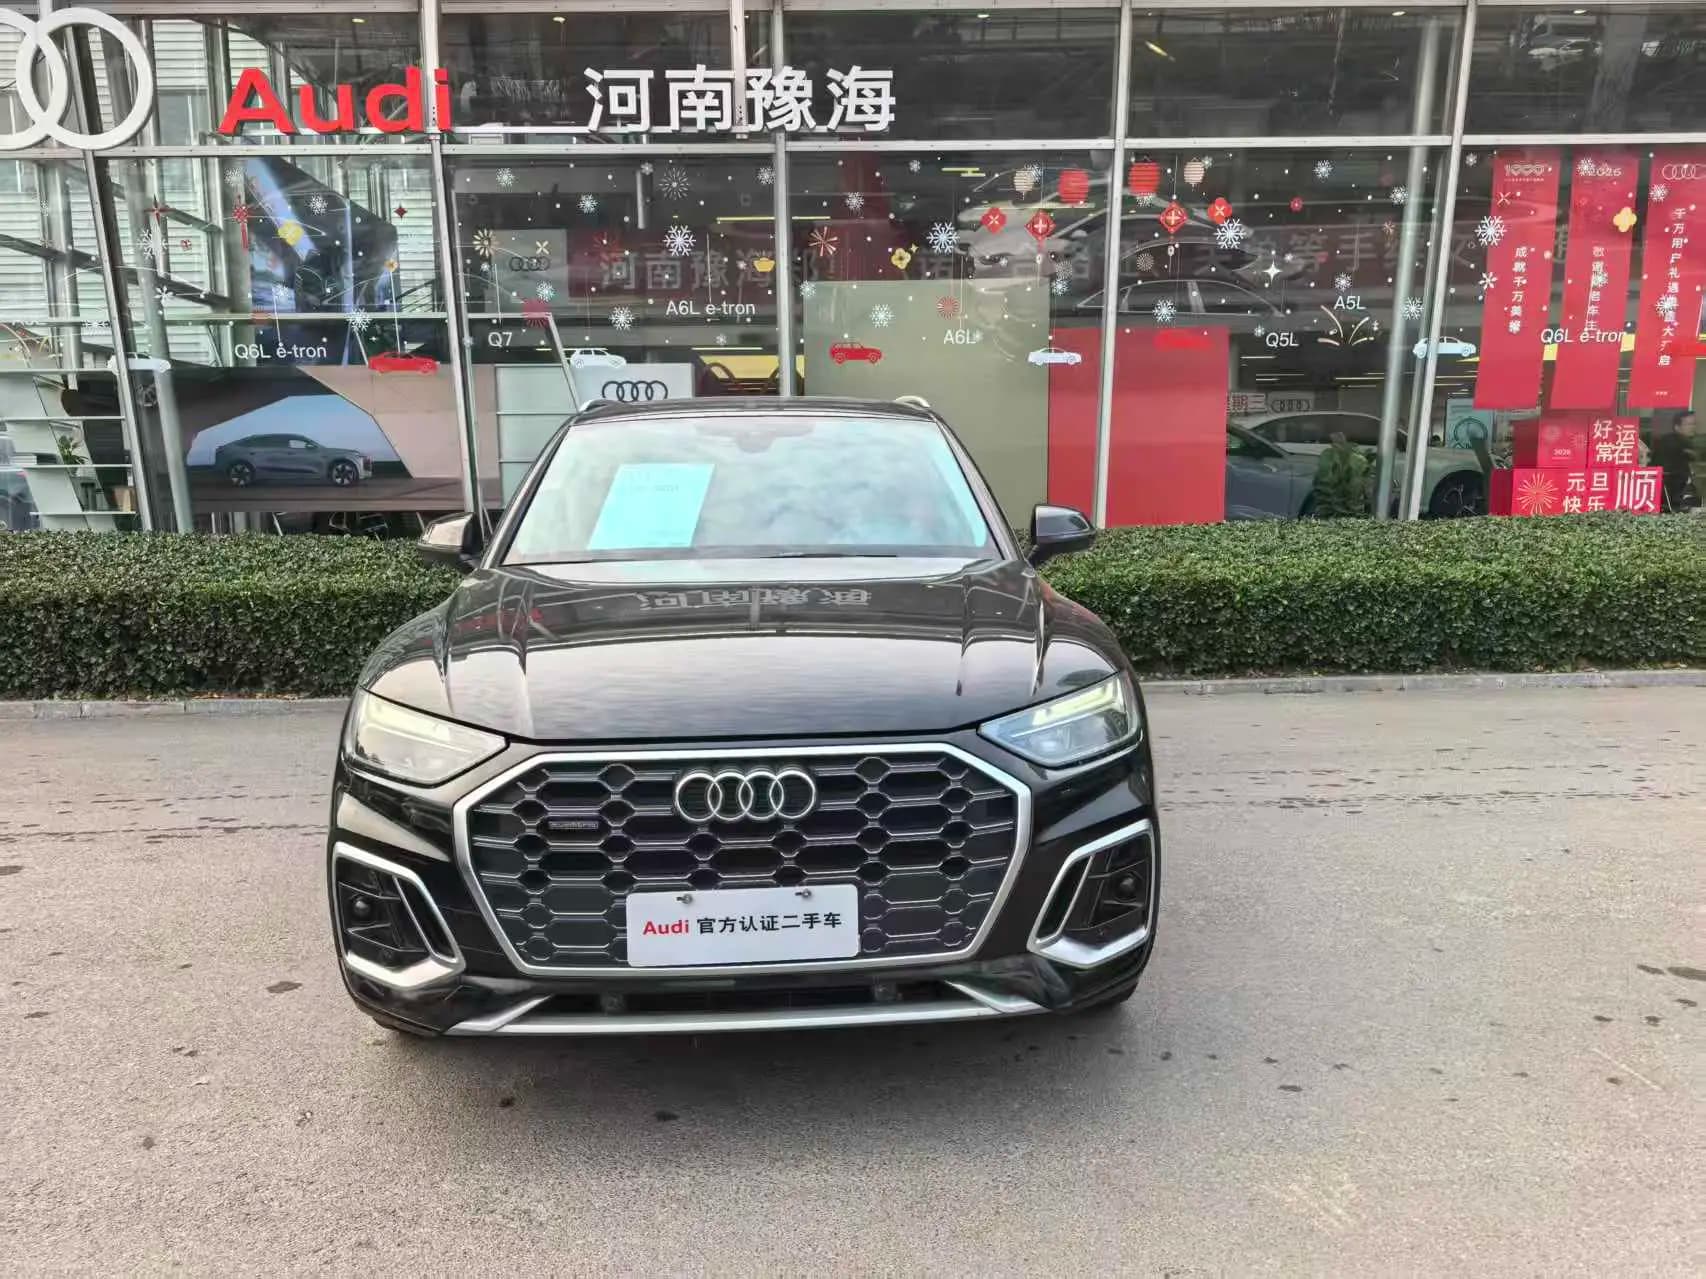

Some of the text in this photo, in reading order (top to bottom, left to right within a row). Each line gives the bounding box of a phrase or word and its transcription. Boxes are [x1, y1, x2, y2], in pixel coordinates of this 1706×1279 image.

[219, 67, 454, 135] Audi
[583, 63, 896, 133] 河南豫海
[666, 300, 756, 316] A6L e-tron
[1333, 295, 1367, 310] A5L
[487, 332, 513, 347] Q7
[943, 329, 977, 345] A6L
[1265, 332, 1300, 348] Q5L
[1540, 328, 1574, 344] Q6L
[234, 343, 327, 359] Q6L e-tron
[1593, 419, 1638, 444] 好运
[1595, 441, 1634, 465] 常在
[1566, 471, 1610, 492] 元旦
[1614, 469, 1658, 512] 顺
[1561, 494, 1607, 513] 快乐
[642, 912, 843, 936] Audi 官方认证二手车
